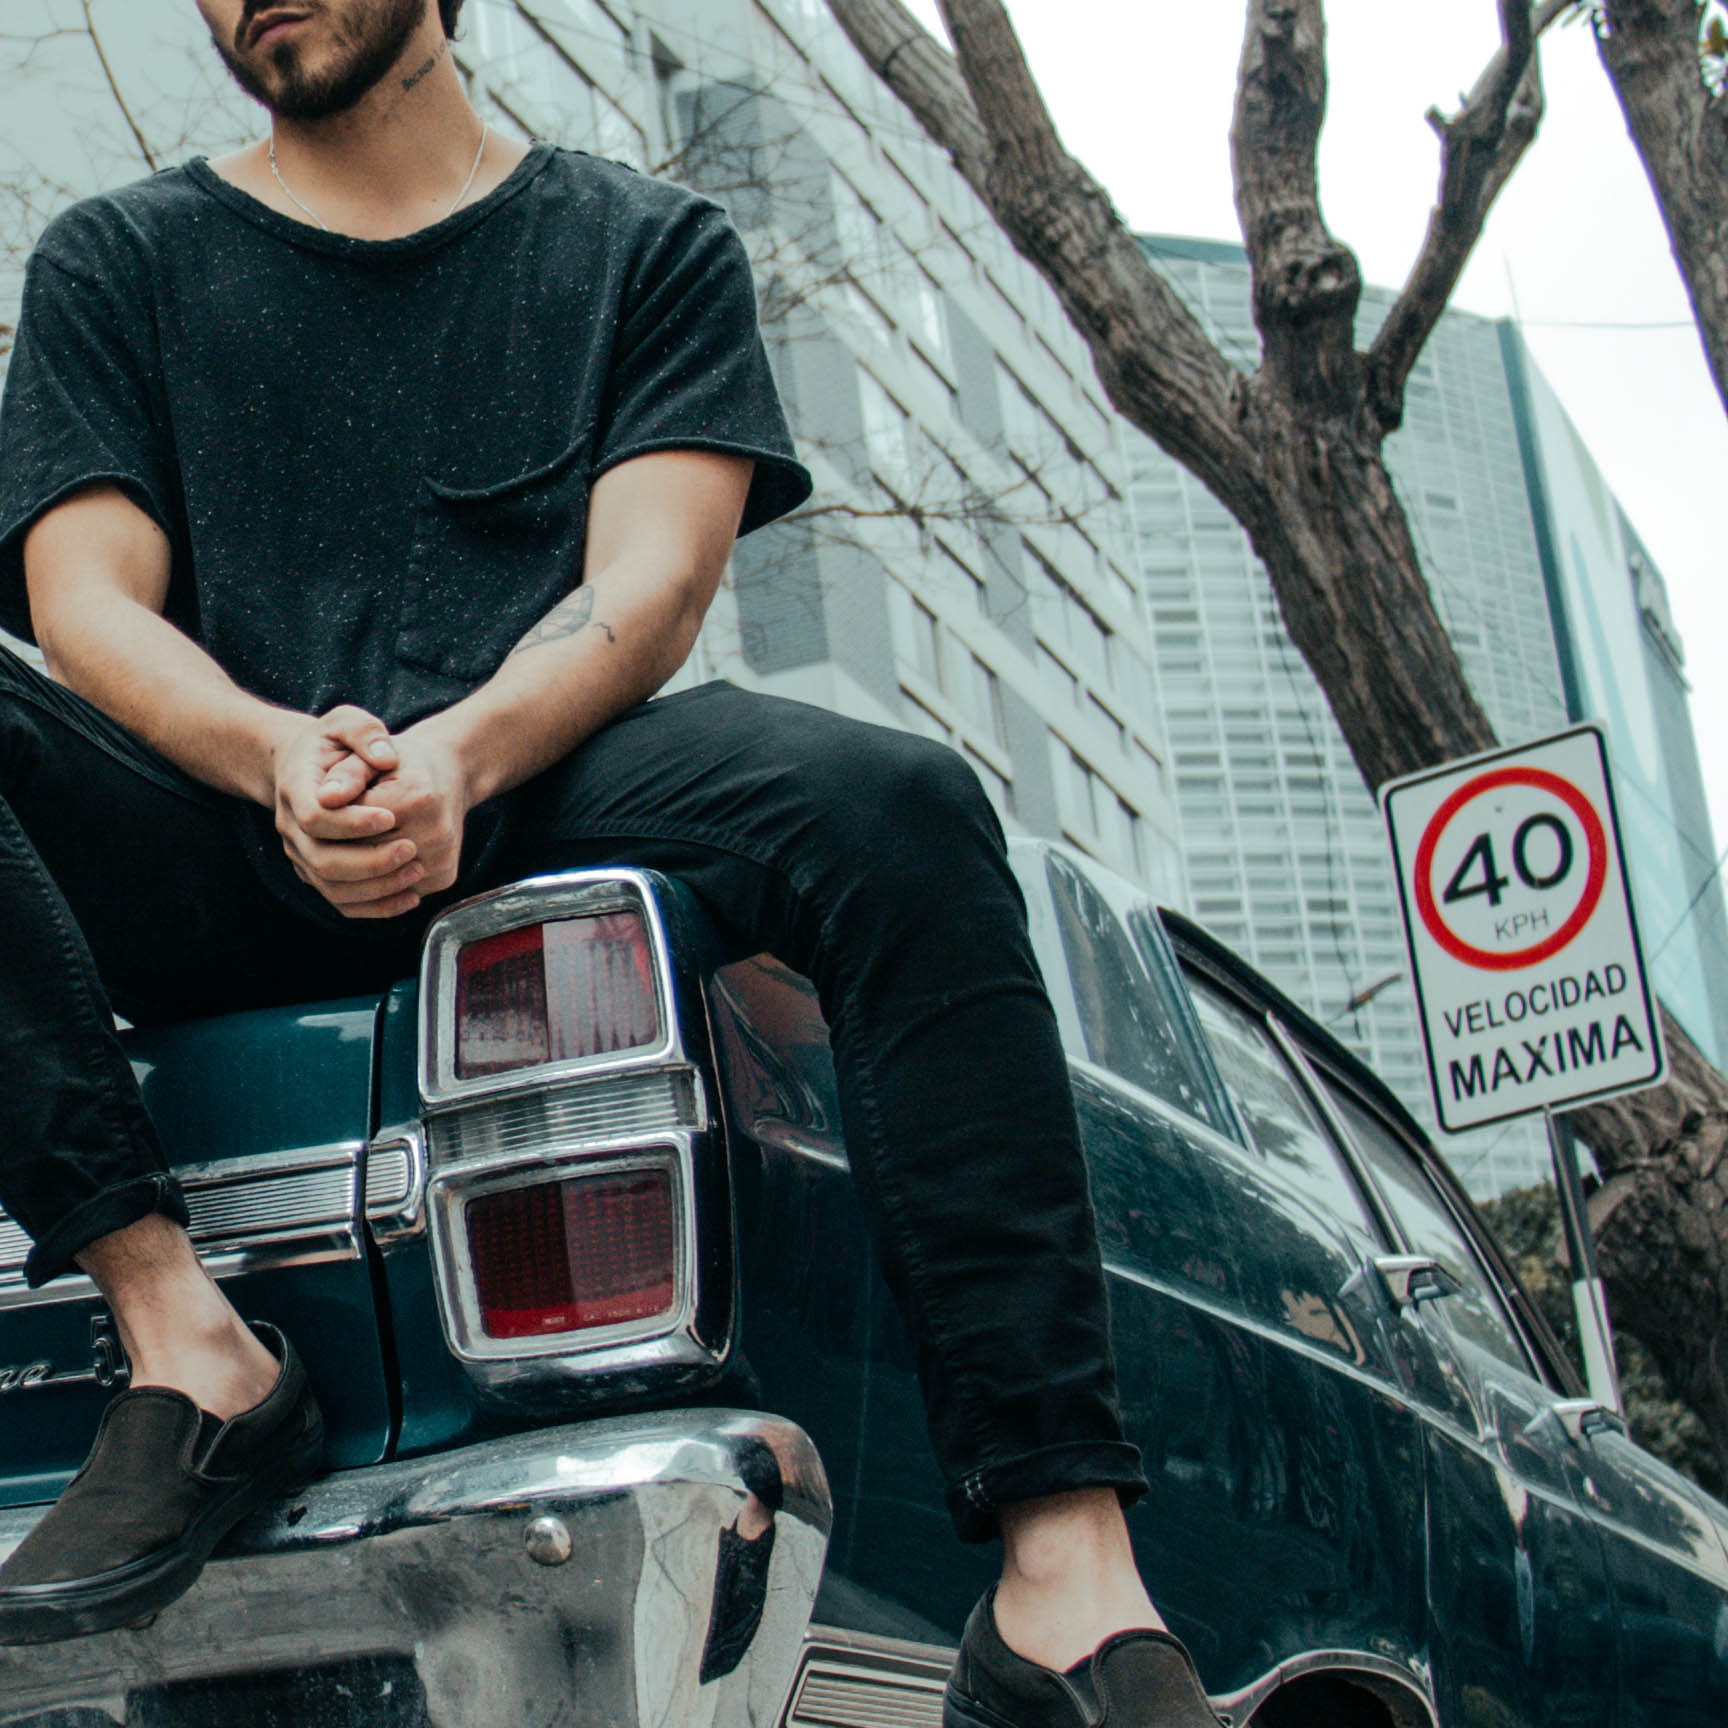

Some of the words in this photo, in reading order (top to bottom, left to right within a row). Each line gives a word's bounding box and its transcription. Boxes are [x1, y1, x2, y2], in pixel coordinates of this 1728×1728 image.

[1442, 812, 1574, 907] 40
[1494, 908, 1549, 943] KPH
[1443, 963, 1627, 1039] VELOCIDAD
[1449, 1014, 1644, 1102] MAXIMA
